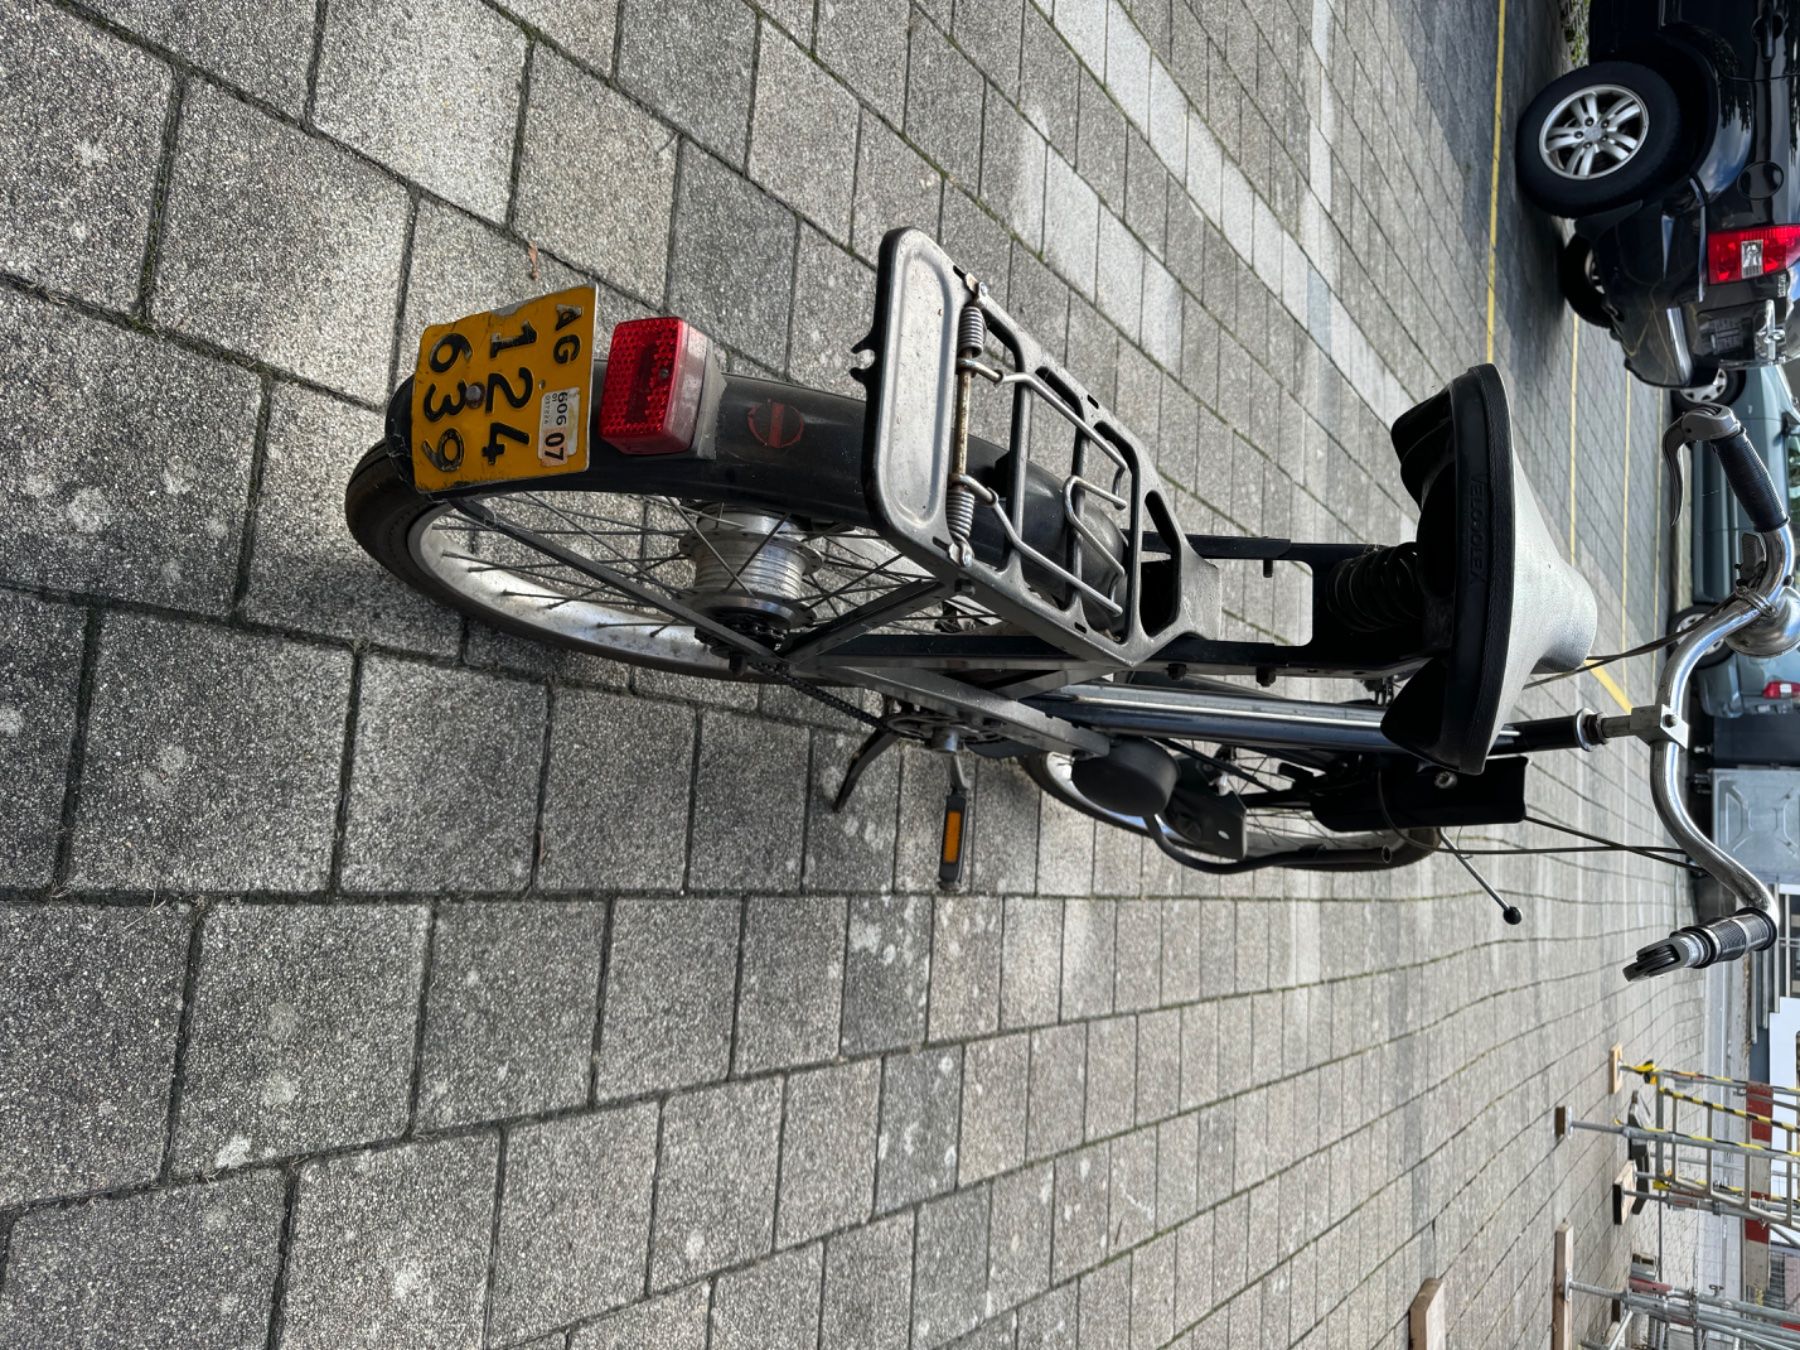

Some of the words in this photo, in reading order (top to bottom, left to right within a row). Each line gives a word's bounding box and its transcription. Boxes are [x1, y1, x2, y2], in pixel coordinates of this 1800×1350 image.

[553, 304, 583, 364] AG
[422, 333, 472, 472] 639
[482, 320, 537, 466] 124
[544, 432, 566, 461] 07
